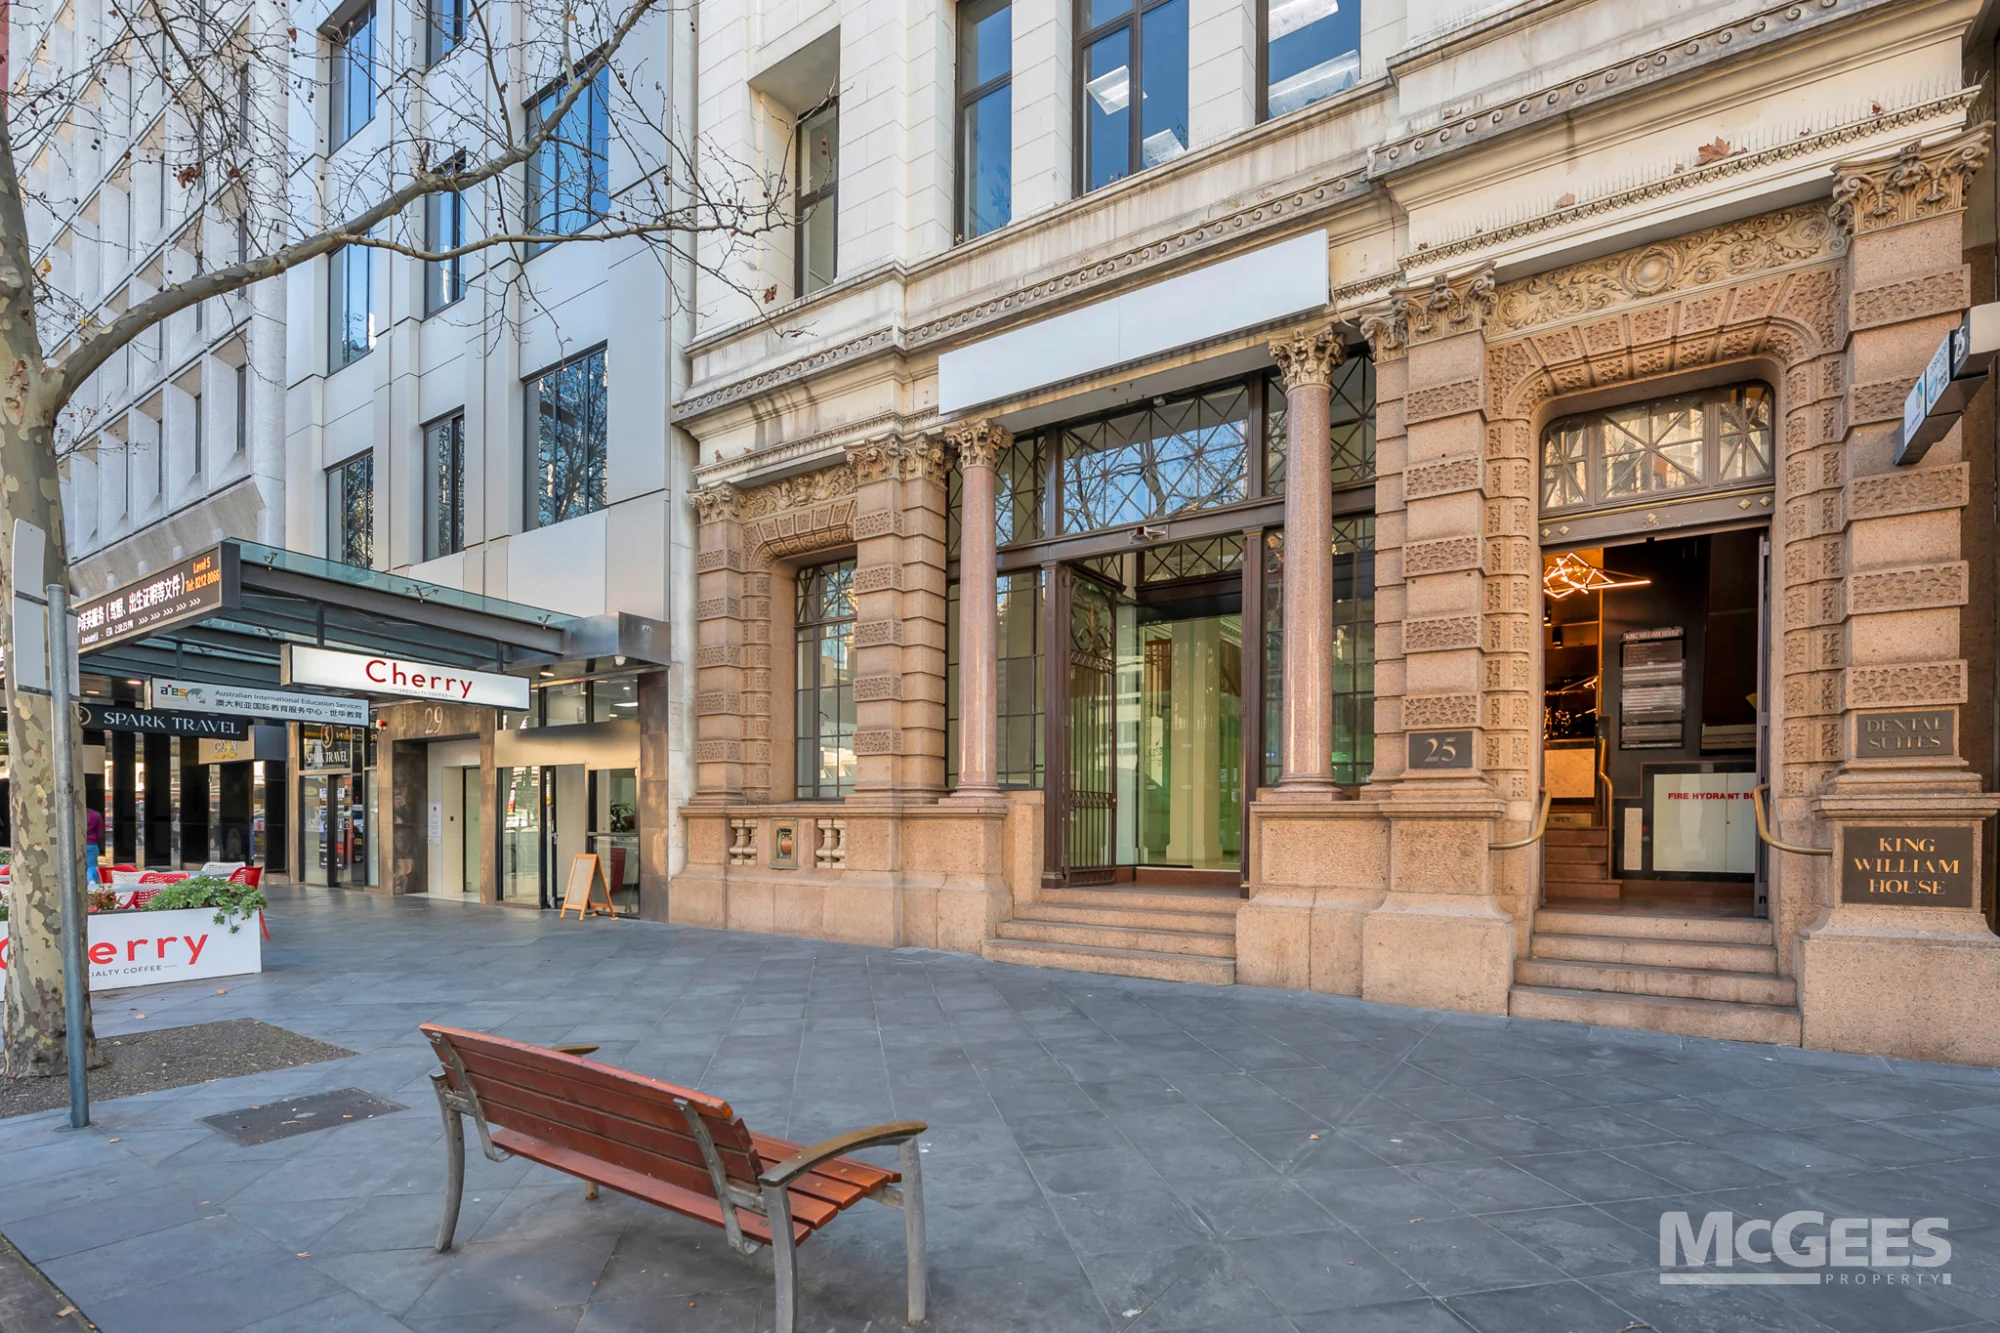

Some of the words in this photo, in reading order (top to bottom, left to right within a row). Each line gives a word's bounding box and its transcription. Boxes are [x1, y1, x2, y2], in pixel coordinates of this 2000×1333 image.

[192, 558, 206, 574] Level
[206, 556, 211, 569] 5
[365, 659, 473, 699] Cherry
[215, 690, 252, 699] Australian
[254, 694, 300, 704] International
[301, 698, 335, 707] Education
[336, 702, 362, 710] Services
[399, 688, 427, 696] SPECIALTY
[104, 712, 166, 729] SPARK
[172, 716, 241, 735] TRAVEL
[425, 706, 444, 734] 29
[1866, 717, 1945, 733] DENTAL
[1424, 737, 1457, 762] 25
[1869, 735, 1941, 750] SUITES
[325, 751, 348, 762] TRAVEL
[1668, 792, 1689, 800] FIRE
[1692, 792, 1740, 800] HYDRANT
[1879, 838, 1935, 853] KING
[1854, 858, 1960, 875] WILLIAM
[1869, 879, 1946, 895] HOUSE
[90, 968, 120, 978] IALTY
[124, 965, 162, 975] COFFEE
